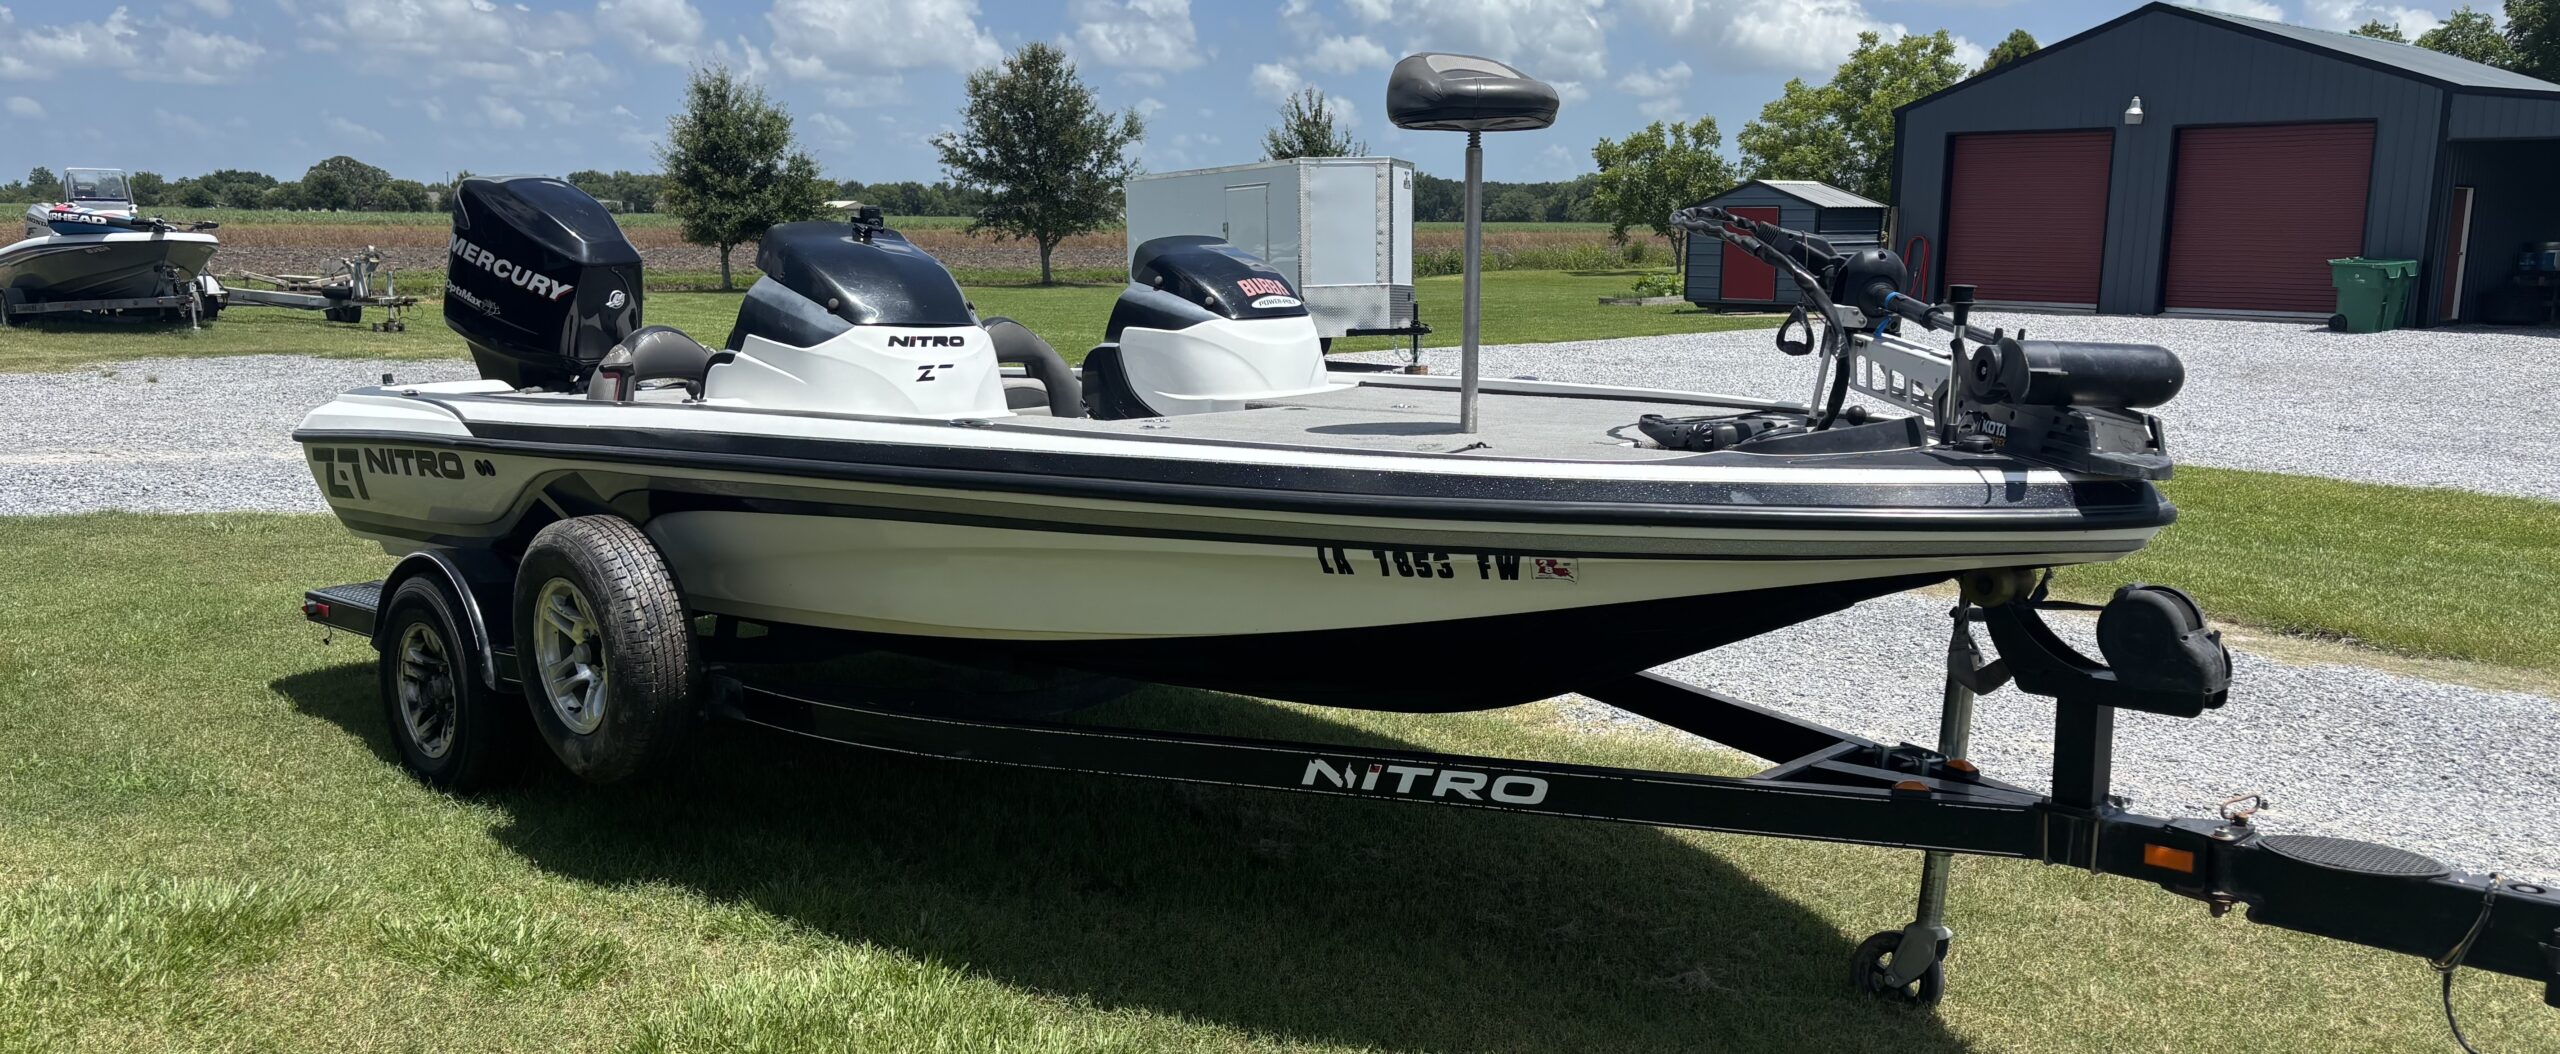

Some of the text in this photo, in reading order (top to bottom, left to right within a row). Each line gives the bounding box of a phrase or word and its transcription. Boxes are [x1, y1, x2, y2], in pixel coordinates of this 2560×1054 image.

[449, 233, 575, 301] MERCURY
[446, 279, 482, 308] OptiMax
[1237, 278, 1291, 297] BUBBA
[887, 335, 965, 347] NITRO
[363, 447, 466, 480] NITRO
[1316, 546, 1520, 580] LA 1853 FW
[1301, 758, 1549, 805] NITRO
